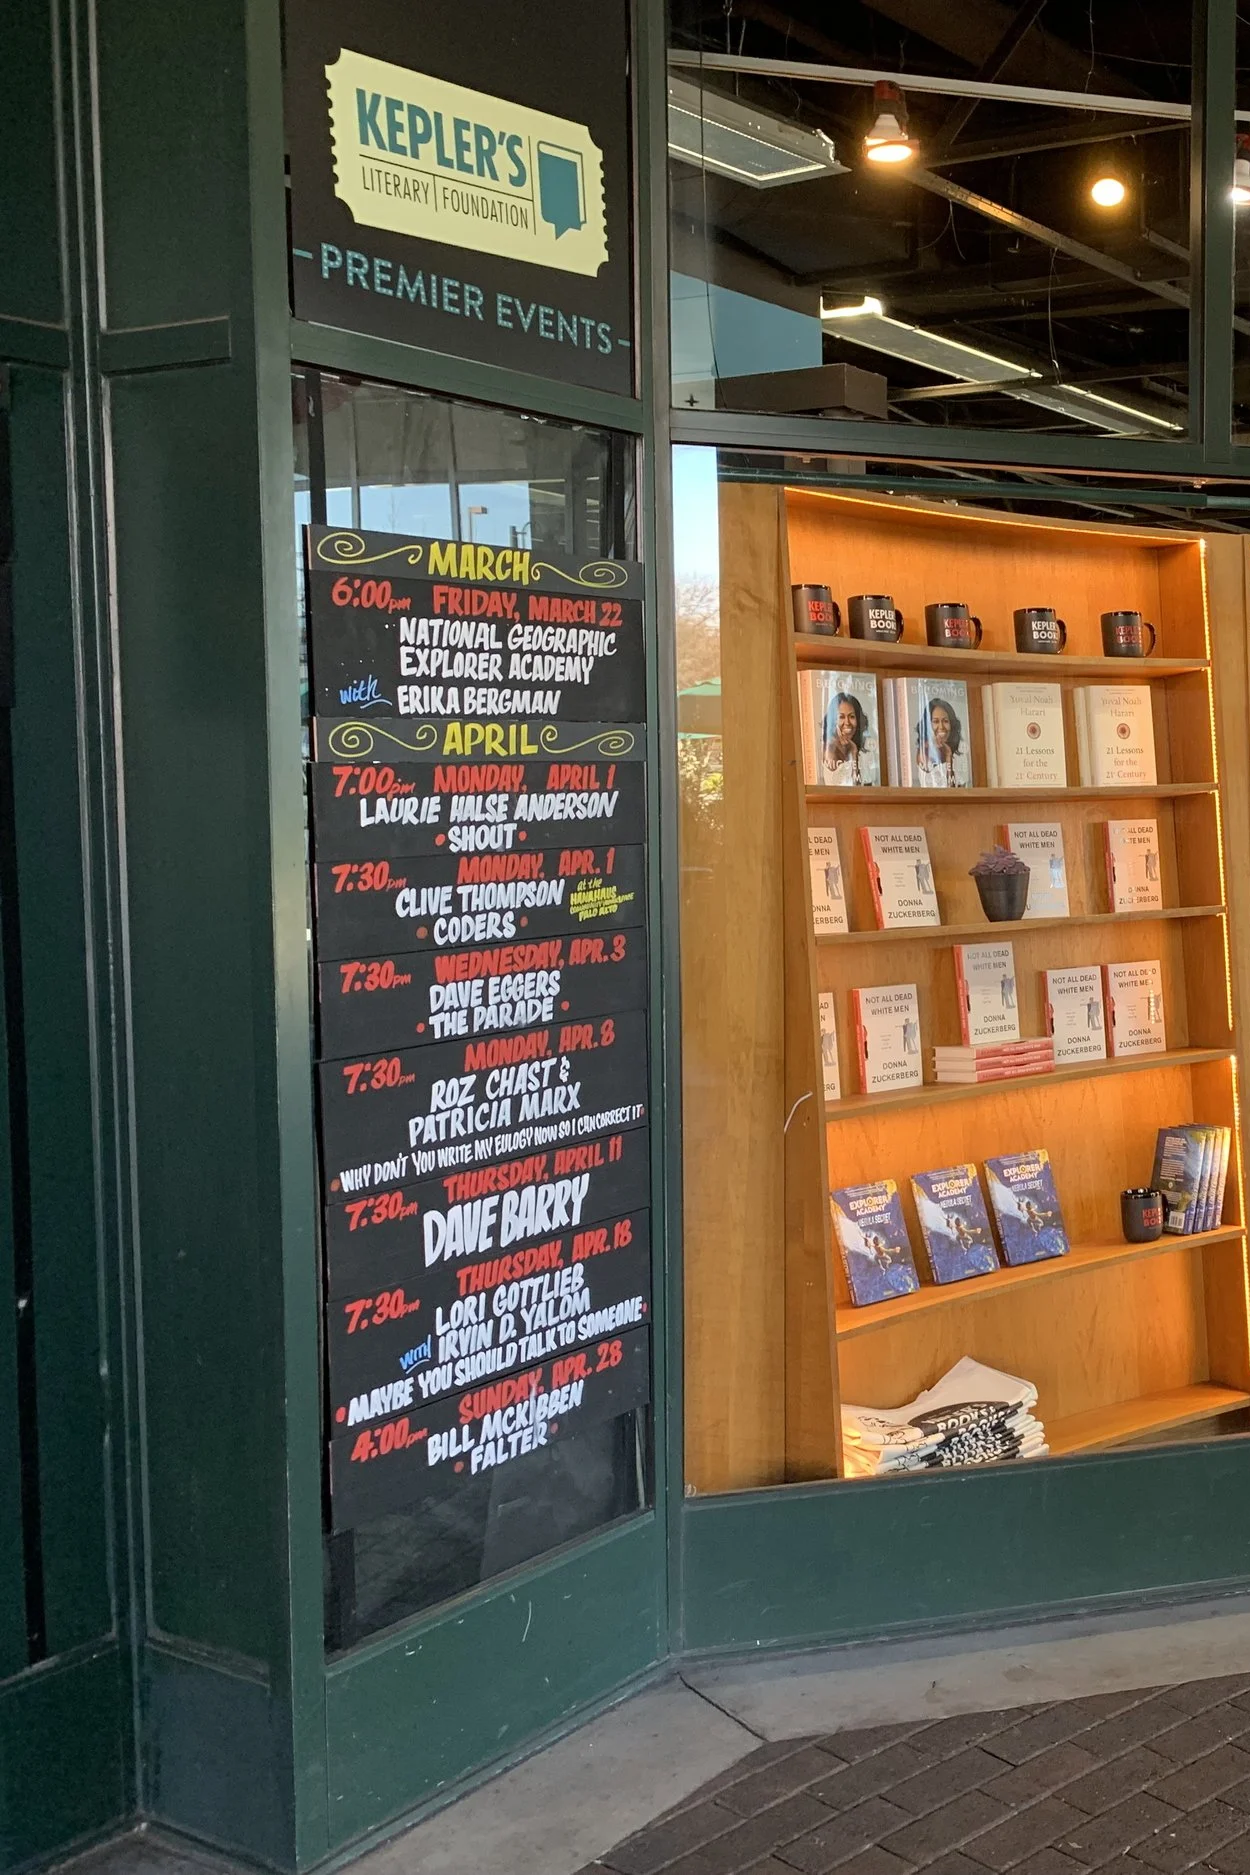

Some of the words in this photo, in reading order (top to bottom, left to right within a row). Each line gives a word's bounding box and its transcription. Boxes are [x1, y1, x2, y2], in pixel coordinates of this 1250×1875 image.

[355, 87, 527, 188] KEPLER'S
[361, 165, 430, 205] LITERARY
[443, 185, 528, 230] FOUNDATION
[320, 242, 484, 322] PREMIER
[496, 293, 612, 355] EVENTS
[428, 542, 530, 585] MARCH
[433, 585, 520, 622] FRIDAY,
[529, 595, 595, 625] MARCH
[599, 602, 622, 627] 22
[400, 617, 502, 650] NATIONAL
[507, 624, 617, 657] GEOGRAPHIC
[400, 646, 503, 682] EXPLORER
[508, 653, 594, 685] ACADEMY
[339, 674, 382, 705] with
[397, 685, 461, 715] ERIKA
[463, 687, 562, 715] BERGMAN
[443, 722, 539, 756] APRIL
[547, 764, 600, 790] APRIL
[607, 764, 617, 789] 1
[360, 797, 441, 828] LAURIE
[449, 794, 509, 824] HALSE
[513, 791, 619, 822] ANDERSON
[448, 823, 518, 853] SHOUT
[558, 849, 600, 876] APR.
[605, 847, 616, 874] 1
[395, 887, 454, 918] CLIVE
[456, 879, 566, 912] THOMPSON
[577, 878, 587, 892] at
[587, 877, 603, 890] the
[433, 911, 516, 945] CODERS
[579, 906, 598, 922] PALO
[598, 904, 618, 917] ALTO
[434, 942, 565, 983] WEDNESDAY,
[569, 939, 608, 966] APR.
[612, 934, 627, 962] 3
[429, 978, 484, 1013] DAVE
[487, 969, 561, 1002] EGGERS
[865, 996, 880, 1004] NOT
[881, 994, 893, 1003] ALL
[894, 992, 913, 1002] DEAD
[871, 1006, 893, 1016] WHITE
[893, 1004, 910, 1013] MEN
[428, 1008, 469, 1039] THE
[473, 997, 554, 1033] PARADE
[559, 1024, 598, 1053] APR.
[600, 1019, 615, 1048] 8
[430, 1074, 477, 1113] ROZ
[485, 1058, 556, 1100] CHAST
[558, 1055, 571, 1083] &
[871, 1070, 919, 1084] ZUCKERBERG
[882, 1059, 907, 1070] DONNA
[408, 1098, 512, 1148] PATRICIA
[517, 1081, 582, 1123] MARX
[339, 1166, 372, 1193] WHY
[374, 1152, 409, 1180] DON'T
[411, 1147, 436, 1172] YOU
[436, 1142, 473, 1167] WRITE
[474, 1137, 495, 1161] MY
[494, 1129, 533, 1155] EULOGY
[533, 1124, 558, 1148] NOW
[558, 1120, 571, 1139] SO
[577, 1114, 597, 1136] CAN
[596, 1107, 630, 1132] CORRECT
[630, 1103, 643, 1121] IT
[554, 1144, 604, 1175] APRIL
[609, 1135, 623, 1161] 11
[423, 1194, 501, 1268] DAVE
[500, 1173, 590, 1247] BARRY
[572, 1228, 610, 1262] APR.
[613, 1218, 633, 1248] 18
[435, 1292, 486, 1335] LORI
[492, 1263, 584, 1317] GOTTLIEB
[400, 1334, 432, 1370] WITH
[438, 1319, 495, 1363] IRVIN
[498, 1312, 517, 1341] D.
[520, 1288, 590, 1334] YALOM
[347, 1376, 414, 1427] MAYBE
[418, 1362, 452, 1399] YOU
[454, 1342, 518, 1387] SHOULD
[518, 1330, 557, 1364] TALK
[557, 1320, 576, 1345] TO
[577, 1296, 643, 1341] SOMEONE
[552, 1359, 591, 1392] APR.
[596, 1340, 623, 1373] 28
[427, 1422, 475, 1467] BILL
[479, 1379, 584, 1438] MCKIBBEN
[470, 1423, 548, 1475] FALTER
